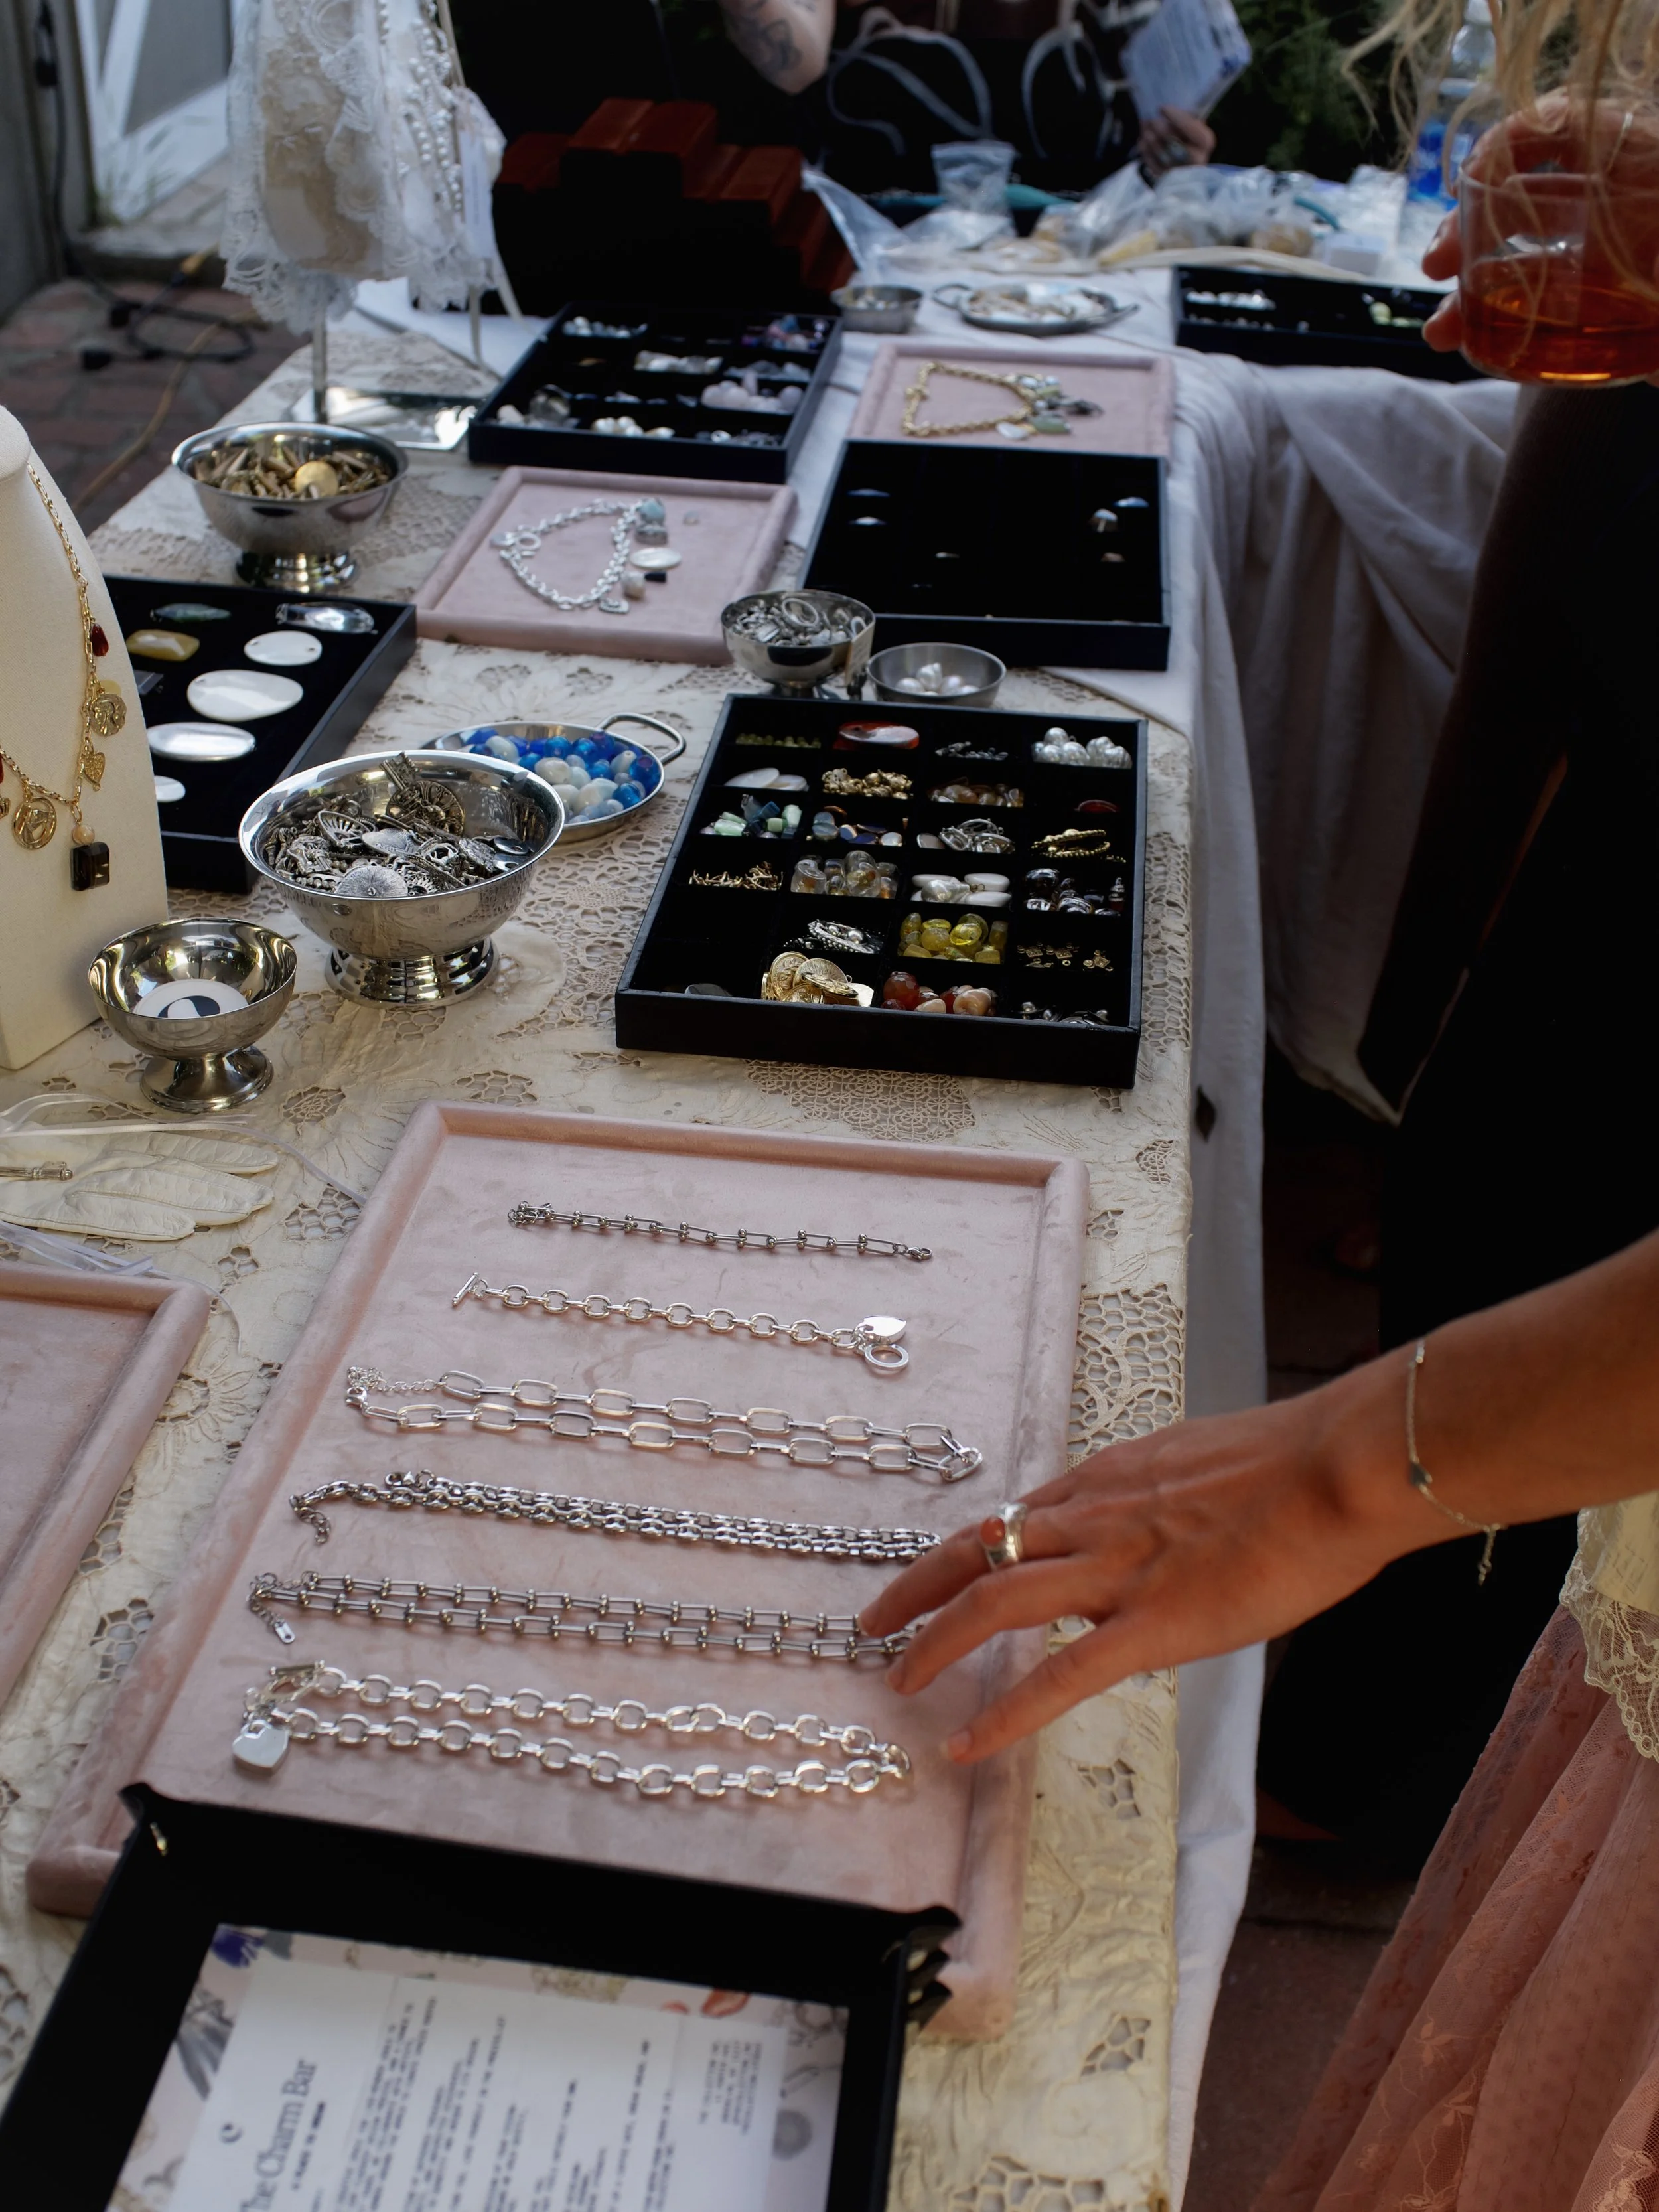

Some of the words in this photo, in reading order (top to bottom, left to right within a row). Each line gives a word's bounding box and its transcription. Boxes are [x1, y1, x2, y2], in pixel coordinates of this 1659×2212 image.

[281, 2059, 316, 2096] Bar
[255, 2103, 303, 2179] Charm
[240, 2181, 277, 2212] he
